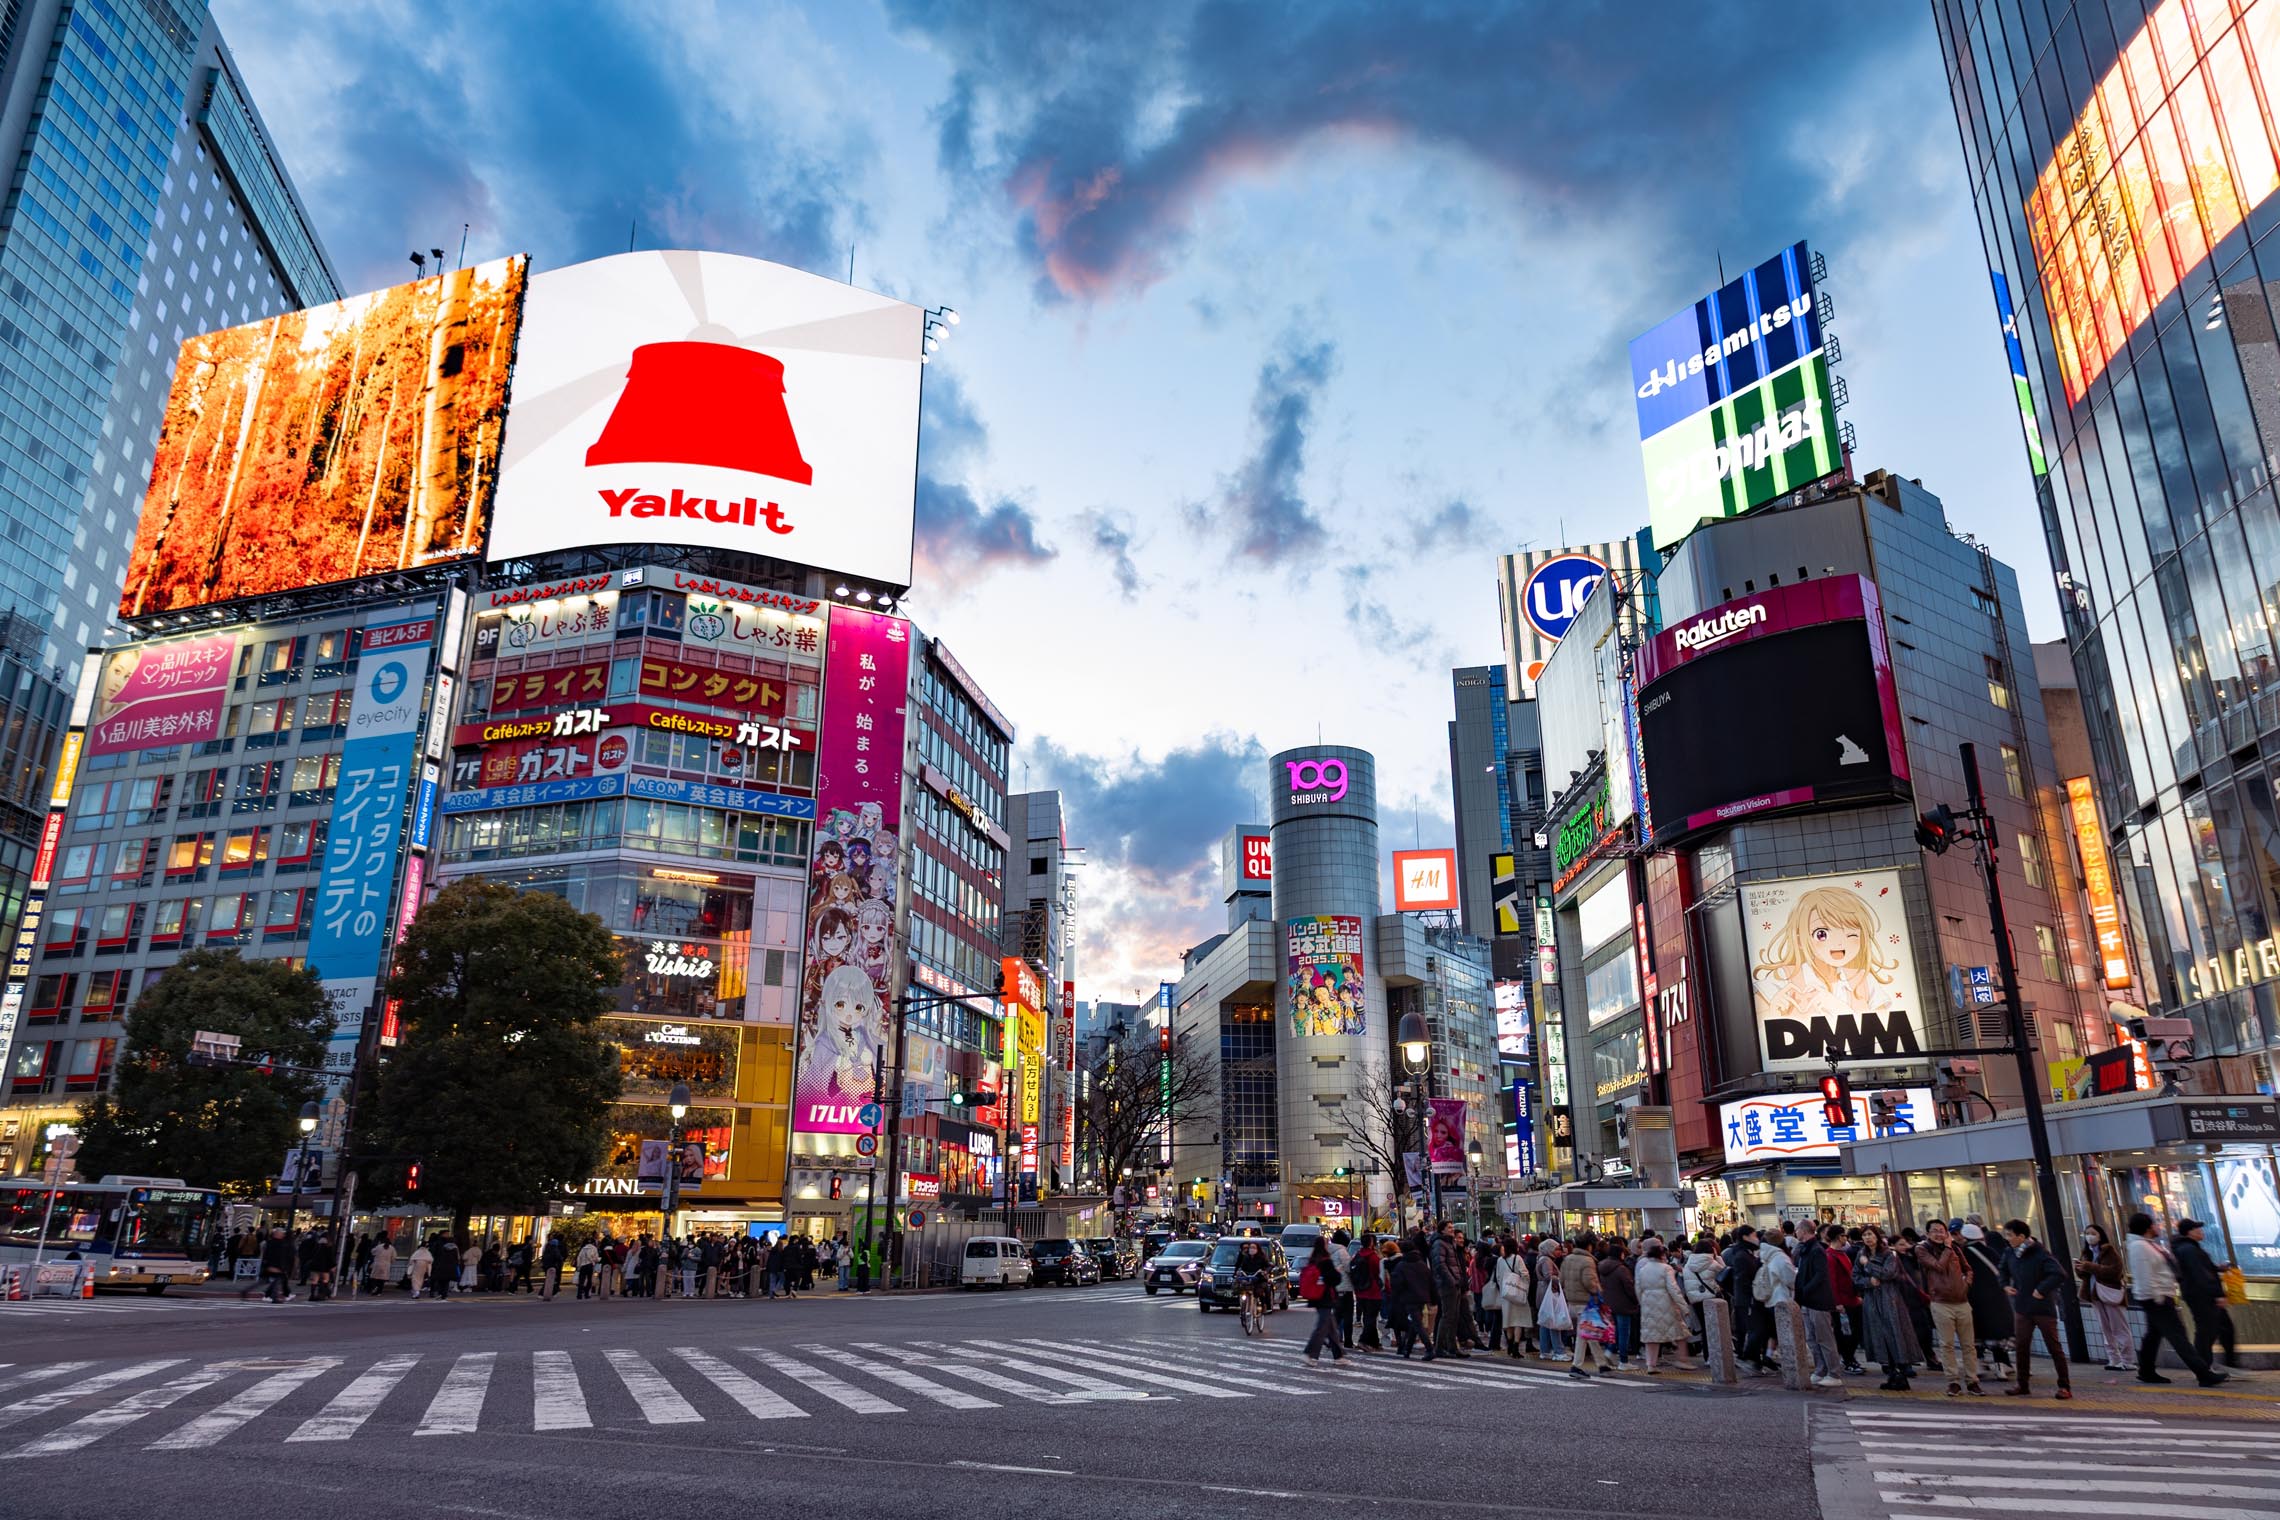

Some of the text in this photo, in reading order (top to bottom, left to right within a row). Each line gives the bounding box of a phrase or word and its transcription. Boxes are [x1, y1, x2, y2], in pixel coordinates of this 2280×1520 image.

[1637, 292, 1811, 399] Hisamitsu
[598, 488, 794, 535] Yakult
[490, 574, 612, 607] しゃぶしゃぶバイキング
[674, 573, 820, 614] しゃぶしゃぶバイキング
[369, 624, 428, 646] 当ビル5F
[541, 605, 611, 638] しゃぶ葉
[733, 615, 818, 652] しゃぶ葉
[1675, 604, 1767, 651] Rakuten
[477, 628, 499, 645] 9F
[160, 645, 228, 671] 品川スキン
[157, 666, 218, 689] クリニック
[495, 666, 604, 705] プライス
[642, 662, 781, 707] コンタクト
[357, 706, 411, 729] eyecity
[1644, 691, 1671, 716] SHIBUYA
[108, 708, 213, 744] 品川美容外科
[553, 708, 610, 737] ガスト
[649, 712, 801, 751] Caféレストラン ガスト
[855, 652, 877, 789] 私が、始まる。
[518, 746, 589, 783] ガスト
[602, 750, 625, 760] ガスト
[456, 761, 482, 781] 7F
[1286, 759, 1349, 802] 109
[449, 779, 615, 808] AEON 英会話イーオン 6F
[636, 778, 812, 815] AEON 英会話イーオン
[1291, 793, 1328, 805] SHIBUYA
[1717, 797, 1771, 818] Rakuten Vision
[323, 767, 376, 938] アイシティ
[353, 765, 400, 937] コンタクトの
[1410, 869, 1441, 889] H&M
[1066, 879, 1076, 948] BIC CAMERA
[1288, 935, 1361, 957] 日本武道館
[1298, 954, 1352, 965] 2025.3.14
[645, 954, 714, 978] Ushi8
[7, 985, 23, 994] 3F
[323, 987, 359, 999] ONTACT
[994, 1003, 1005, 1019] 4F
[1763, 1010, 1921, 1060] DMM
[809, 1104, 863, 1124] 17LIV
[1518, 1086, 1527, 1117] MIZUHO
[5, 1124, 19, 1136] 2F
[2205, 1120, 2237, 1131] 渋谷駅
[2237, 1123, 2262, 1133] Shibuya
[968, 1131, 993, 1156] LUSH
